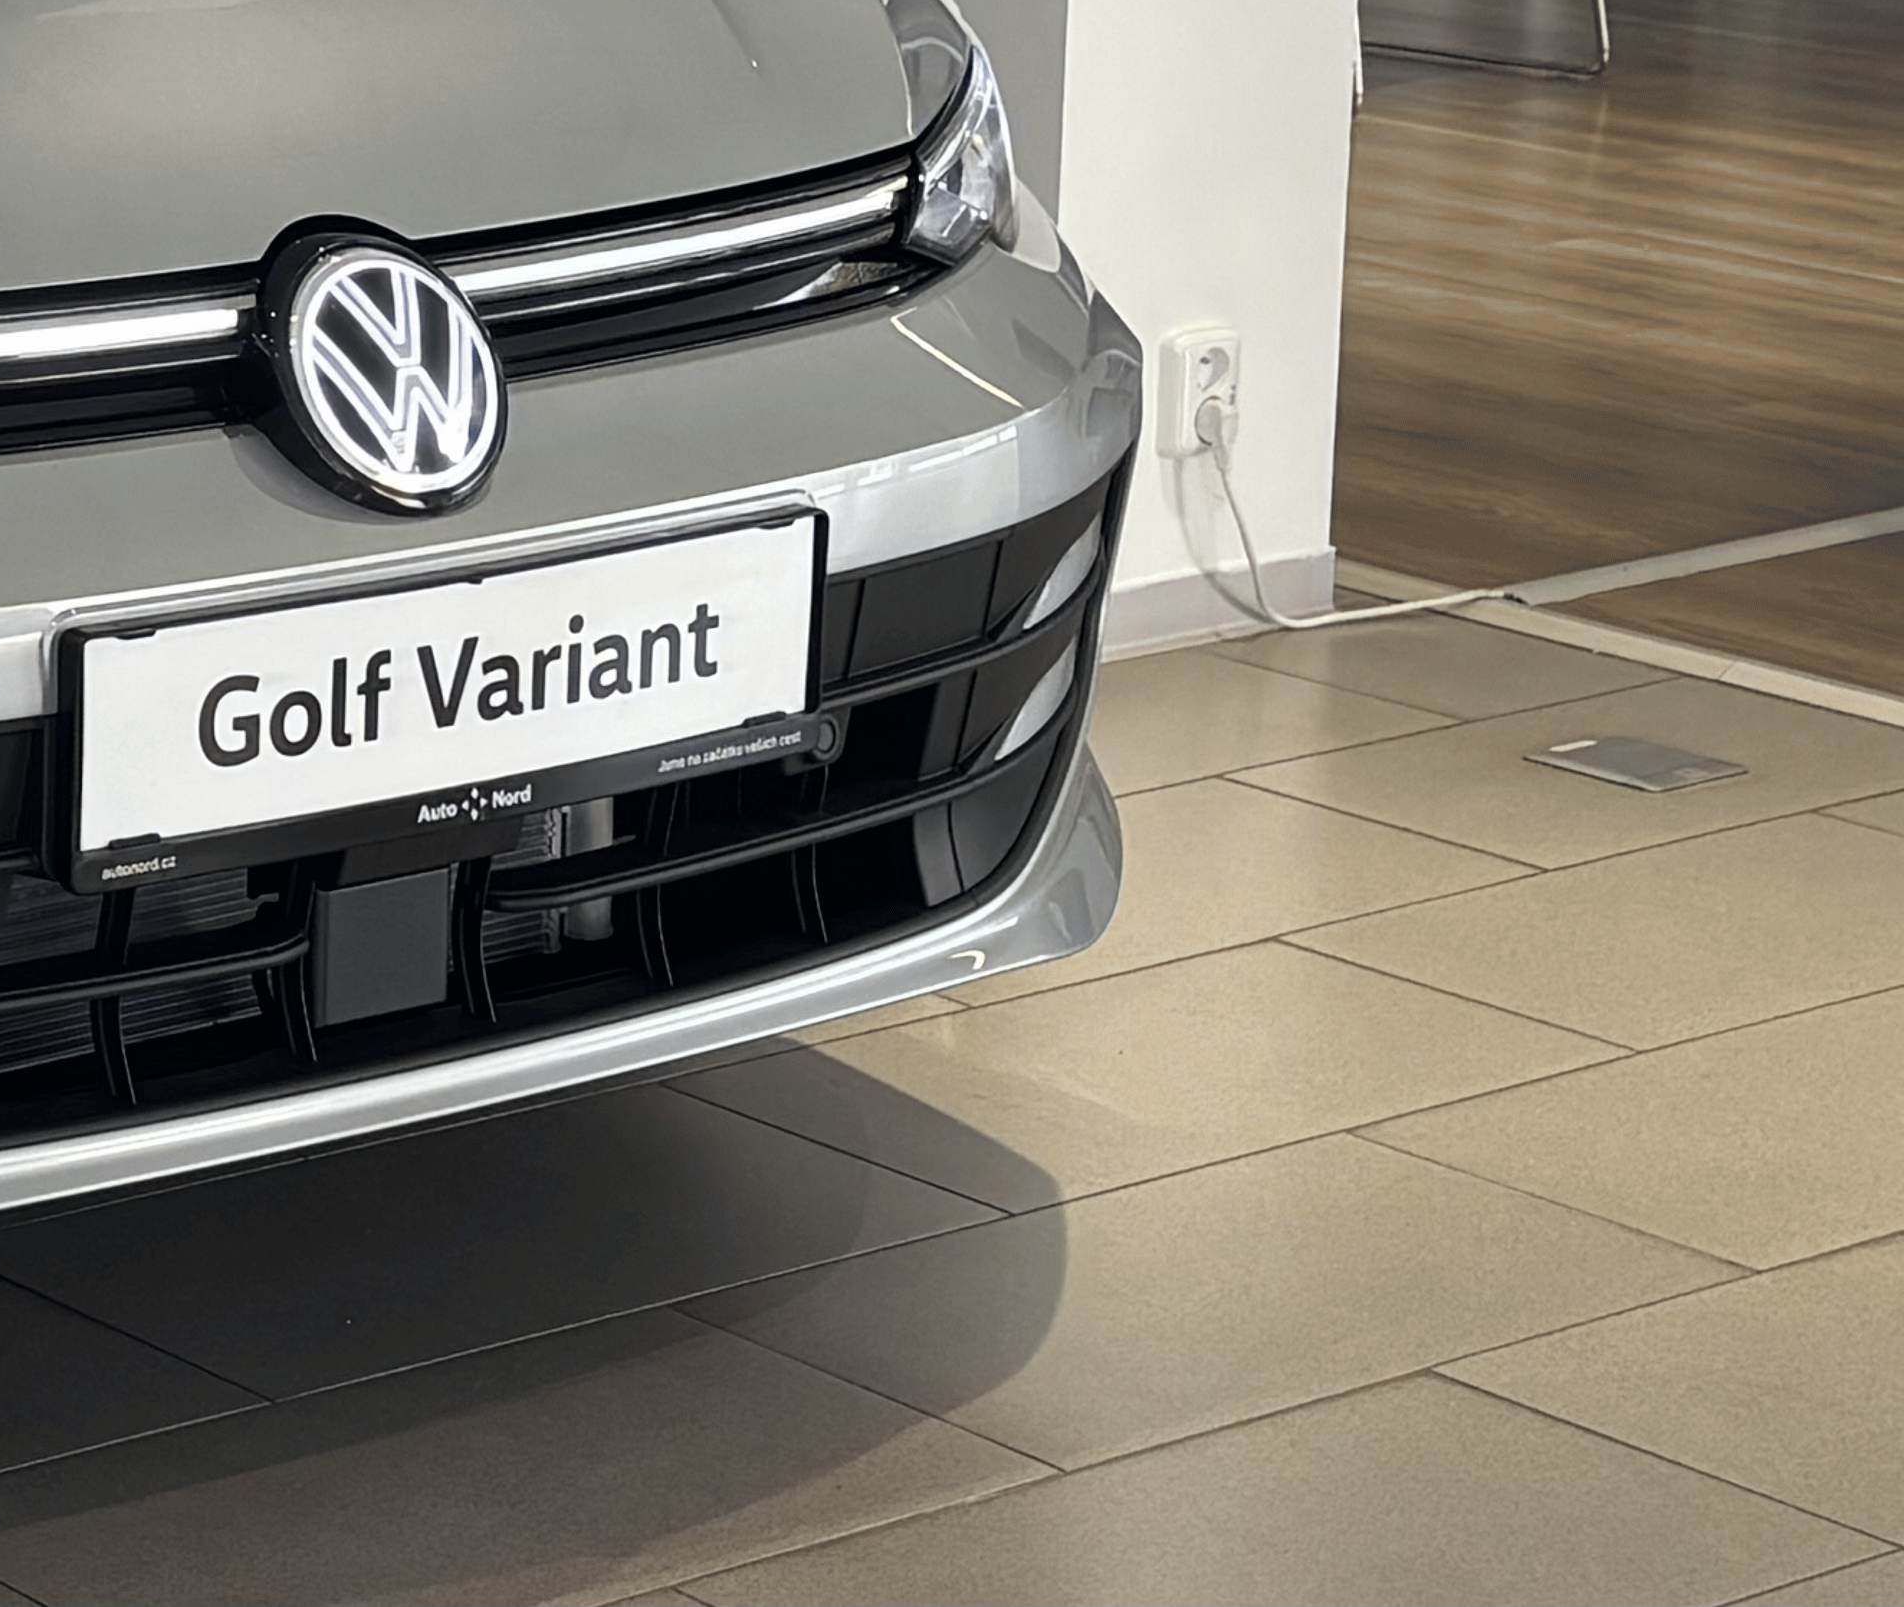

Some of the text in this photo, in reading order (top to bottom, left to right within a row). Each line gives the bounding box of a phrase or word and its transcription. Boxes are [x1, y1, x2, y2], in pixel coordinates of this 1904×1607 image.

[197, 603, 721, 768] Golf Variant
[417, 783, 532, 823] Auto Nord
[101, 855, 177, 881] autonord.cz
